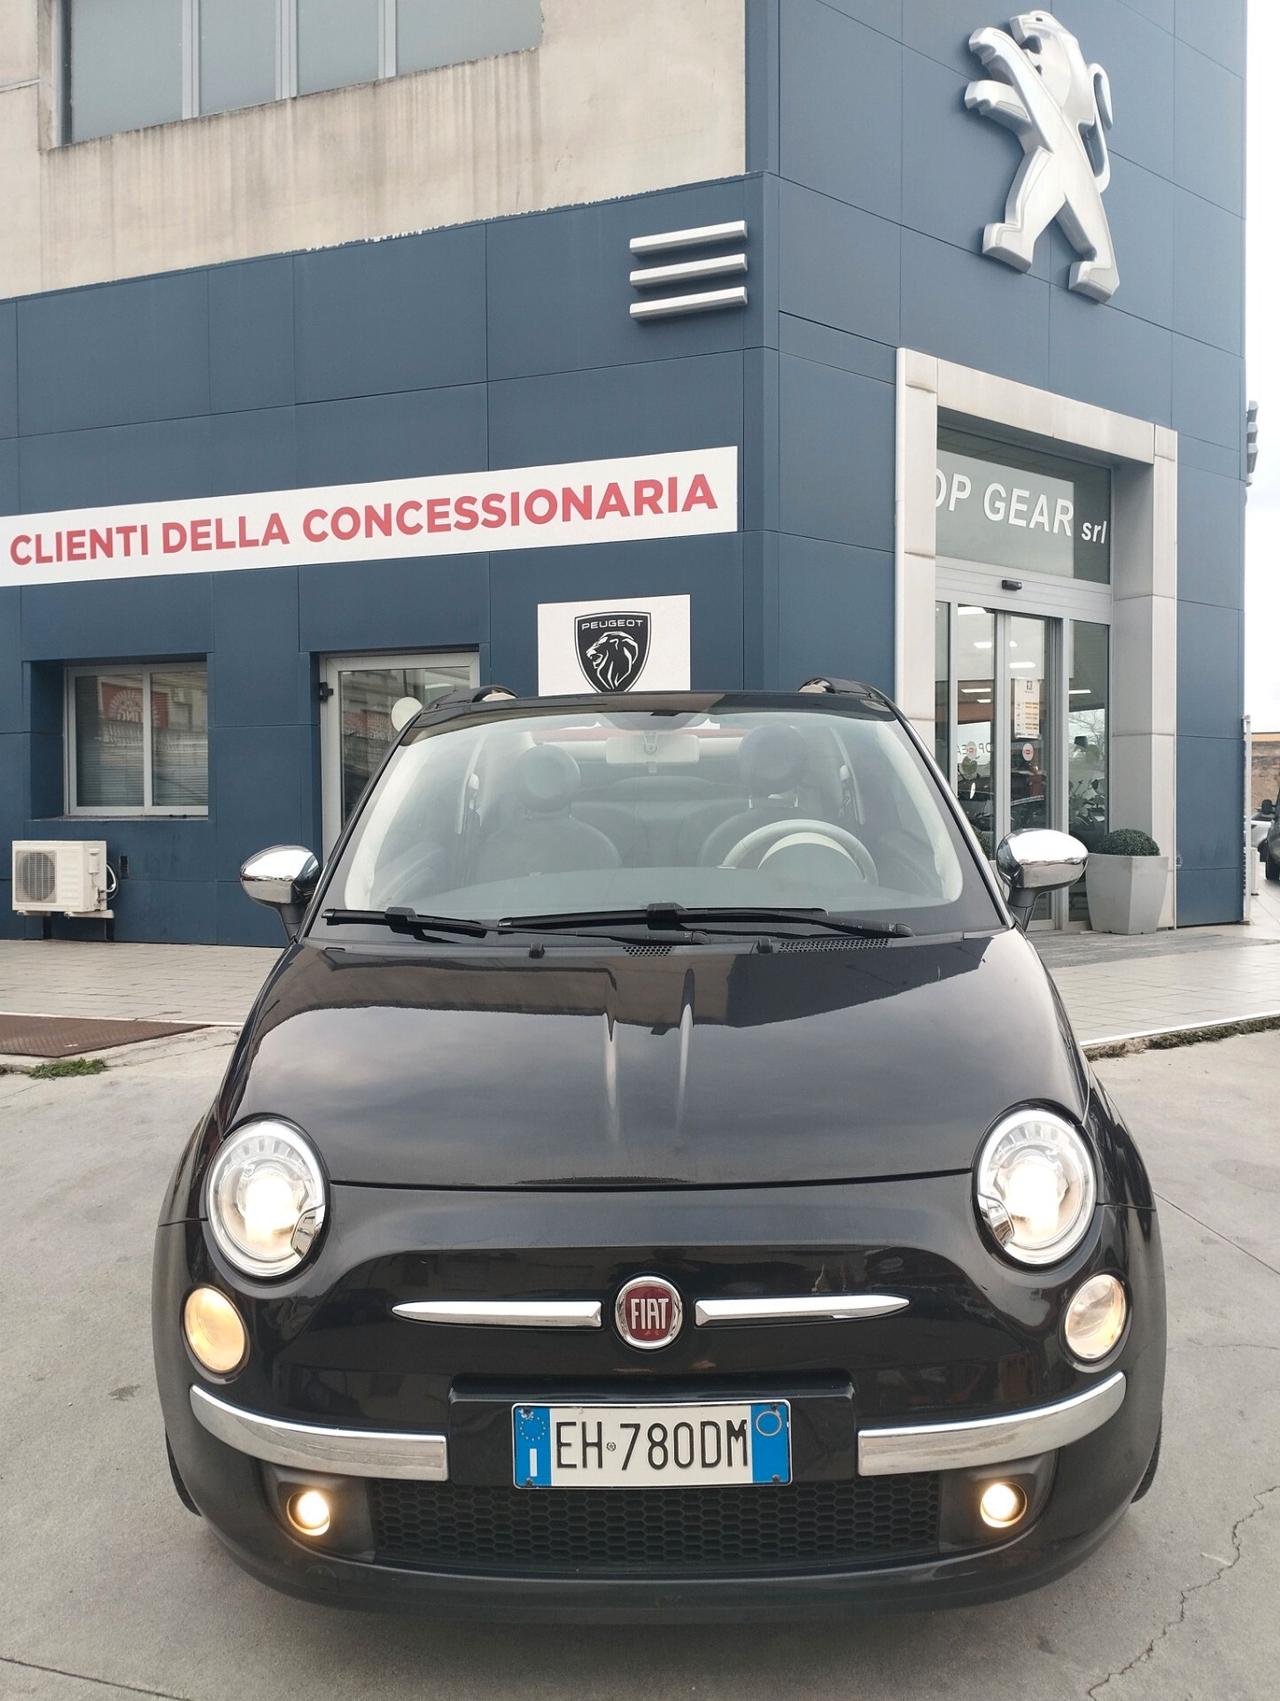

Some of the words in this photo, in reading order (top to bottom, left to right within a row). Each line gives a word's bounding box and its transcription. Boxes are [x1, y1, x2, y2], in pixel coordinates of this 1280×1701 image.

[10, 524, 149, 566] CLIENTI
[162, 512, 290, 554] DELLA
[302, 473, 718, 543] CONCESSIONARIA
[983, 482, 1075, 537] GEAR
[1081, 520, 1107, 544] srl
[581, 619, 644, 631] PEUGEOT
[630, 1298, 669, 1330] FIAT
